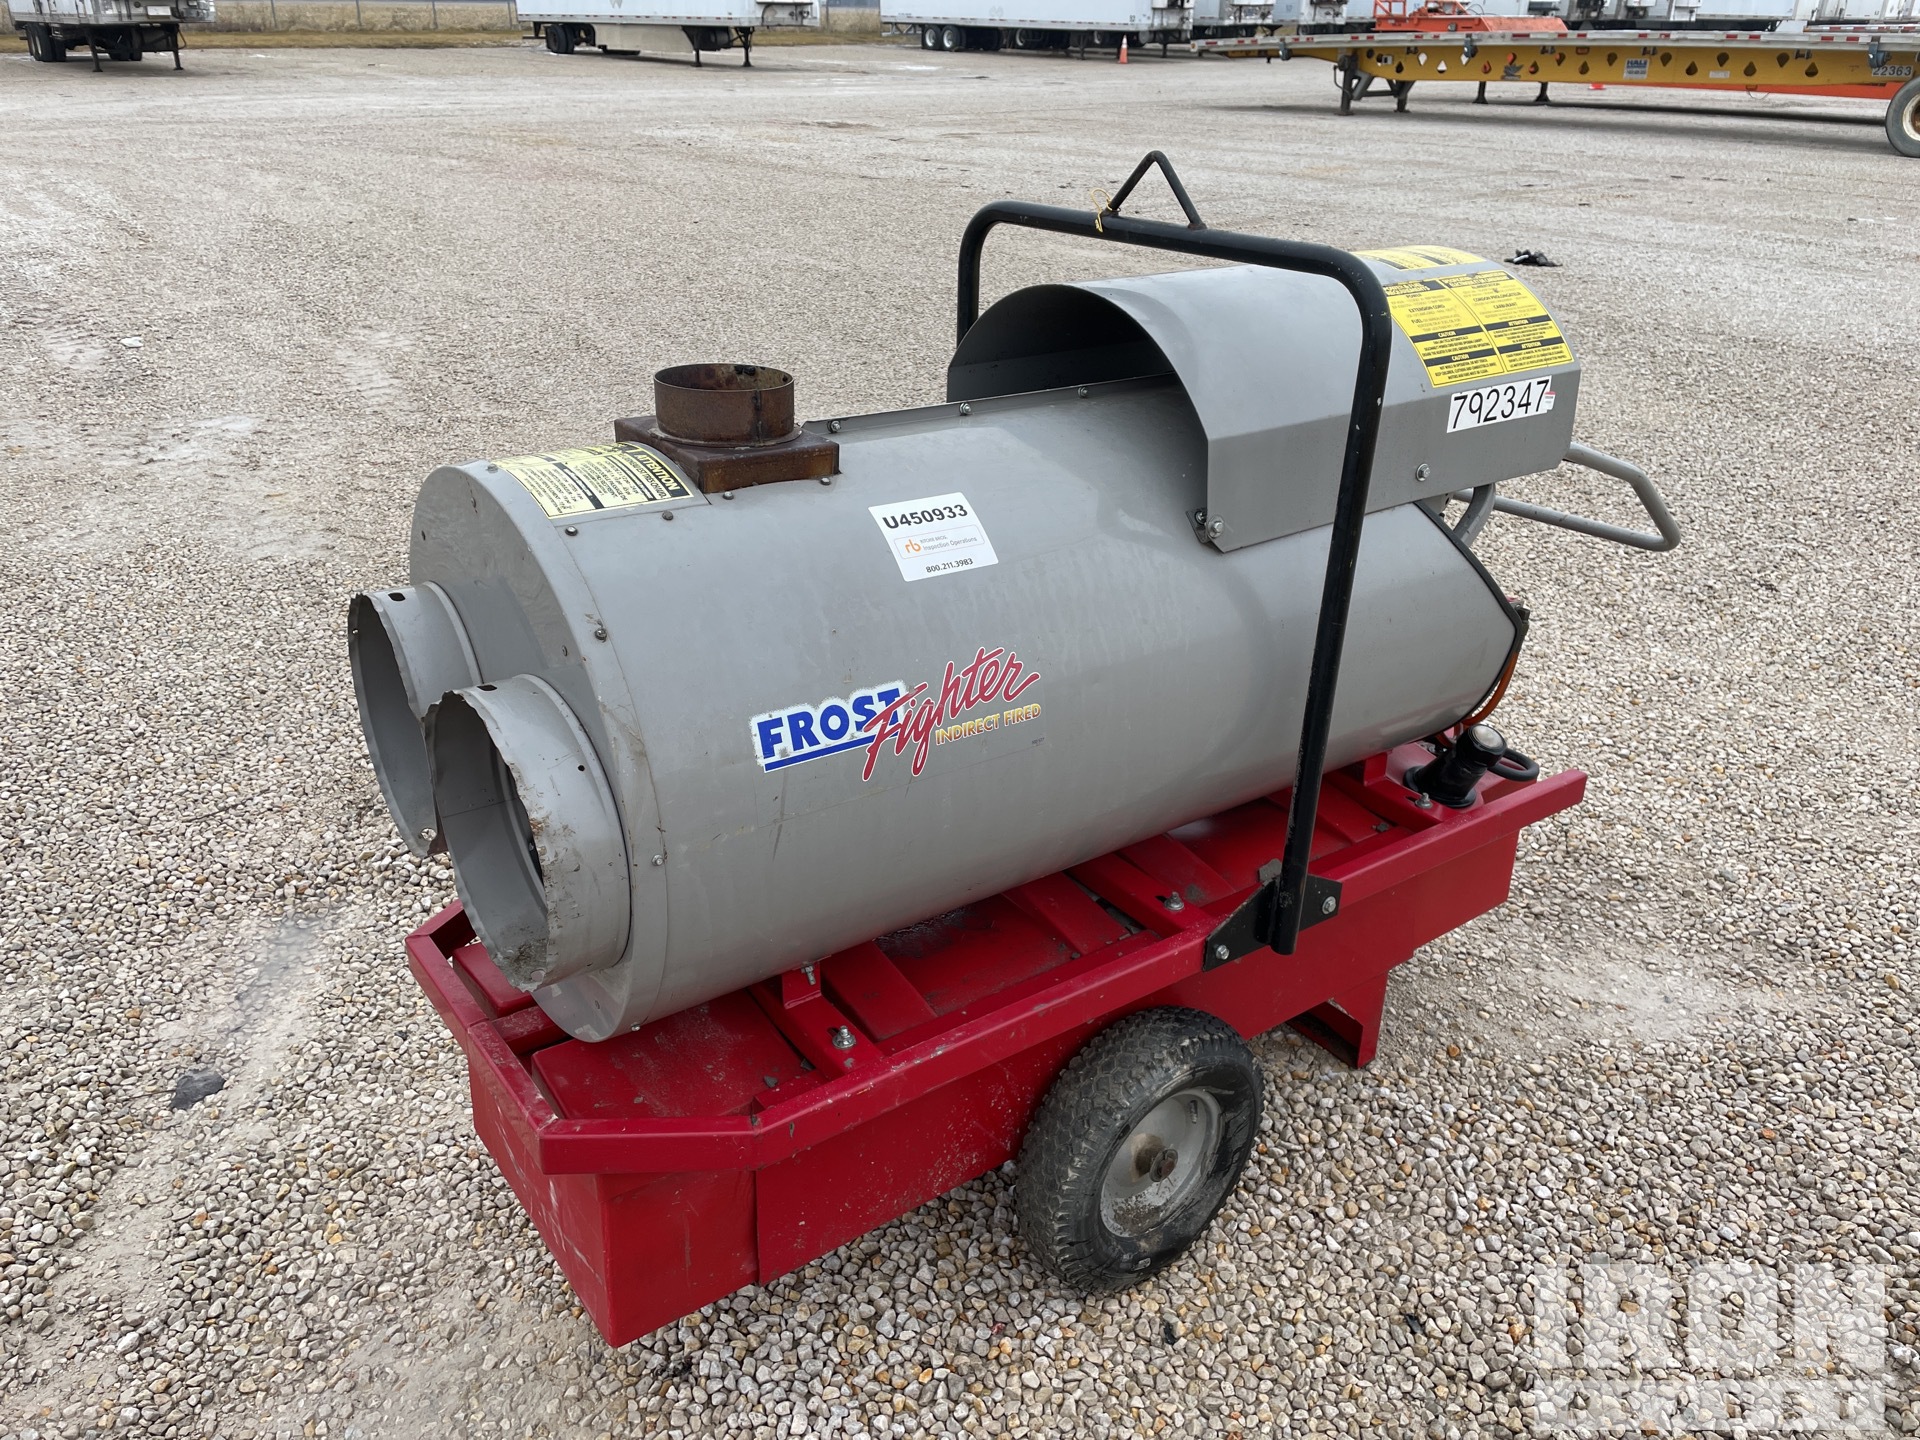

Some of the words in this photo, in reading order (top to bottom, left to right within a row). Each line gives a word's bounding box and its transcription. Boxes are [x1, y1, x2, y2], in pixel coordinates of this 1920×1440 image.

[1873, 65, 1912, 76] 22363
[1438, 330, 1457, 338] CAUTION
[1452, 353, 1470, 361] CAUTION
[1453, 379, 1550, 430] 792347
[634, 453, 681, 491] ATTENTION
[882, 504, 968, 529] U450933
[923, 542, 950, 551] Inspection
[949, 536, 978, 546] Operations
[926, 557, 974, 573] 800.211.3983
[757, 687, 901, 760] FROST
[862, 647, 1040, 781] Fighter
[935, 715, 1001, 746] INDIRECT
[1003, 703, 1042, 727] FIRED
